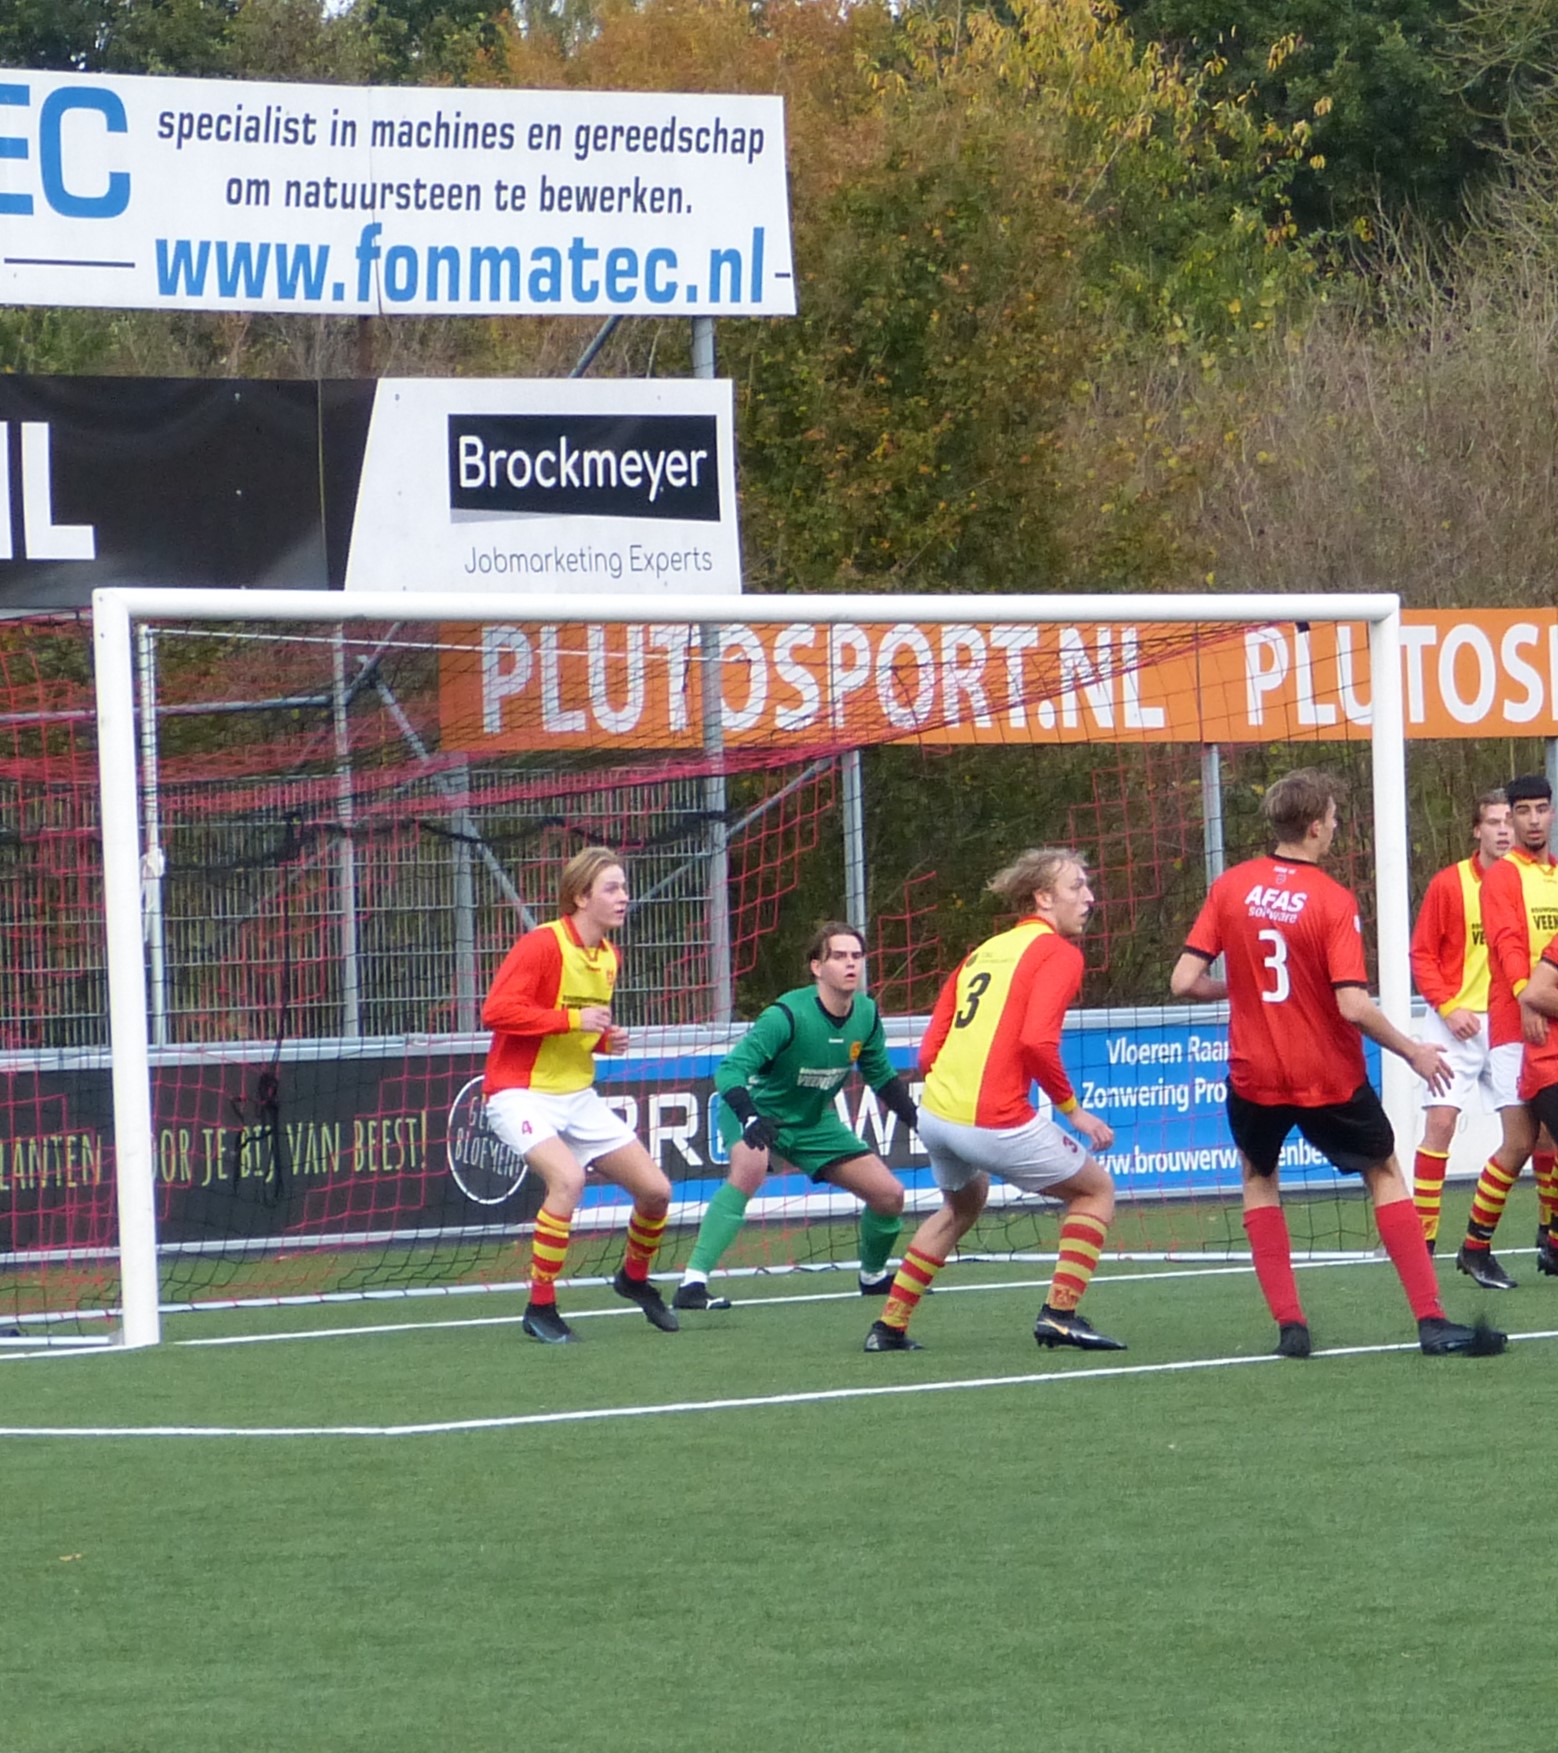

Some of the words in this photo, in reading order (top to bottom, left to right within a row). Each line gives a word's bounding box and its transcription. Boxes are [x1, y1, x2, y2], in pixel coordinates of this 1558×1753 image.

[157, 103, 317, 150] specialist
[330, 109, 357, 148] in
[371, 111, 515, 151] machines
[528, 122, 562, 151] en
[575, 116, 764, 164] gereedschap
[226, 177, 270, 206] om
[285, 176, 481, 211] natuursteen
[495, 179, 526, 211] te
[540, 175, 692, 214] bewerken.
[155, 221, 765, 304] www.fonmatec.nl
[458, 435, 708, 502] Brockmeyer
[464, 546, 623, 579] Jobmarketing
[630, 545, 713, 579] Experts
[481, 623, 1165, 733] PLUTOSPORT.NL
[1245, 885, 1308, 912] AFAS
[1258, 929, 1290, 1003] 3
[954, 972, 991, 1029] 3
[1107, 1039, 1182, 1065] Vloeren
[1081, 1077, 1190, 1111] Zonwering
[202, 1127, 229, 1187] JE
[286, 1120, 340, 1176] VAN
[354, 1108, 428, 1171] BEEST!
[1062, 1135, 1078, 1154] 3
